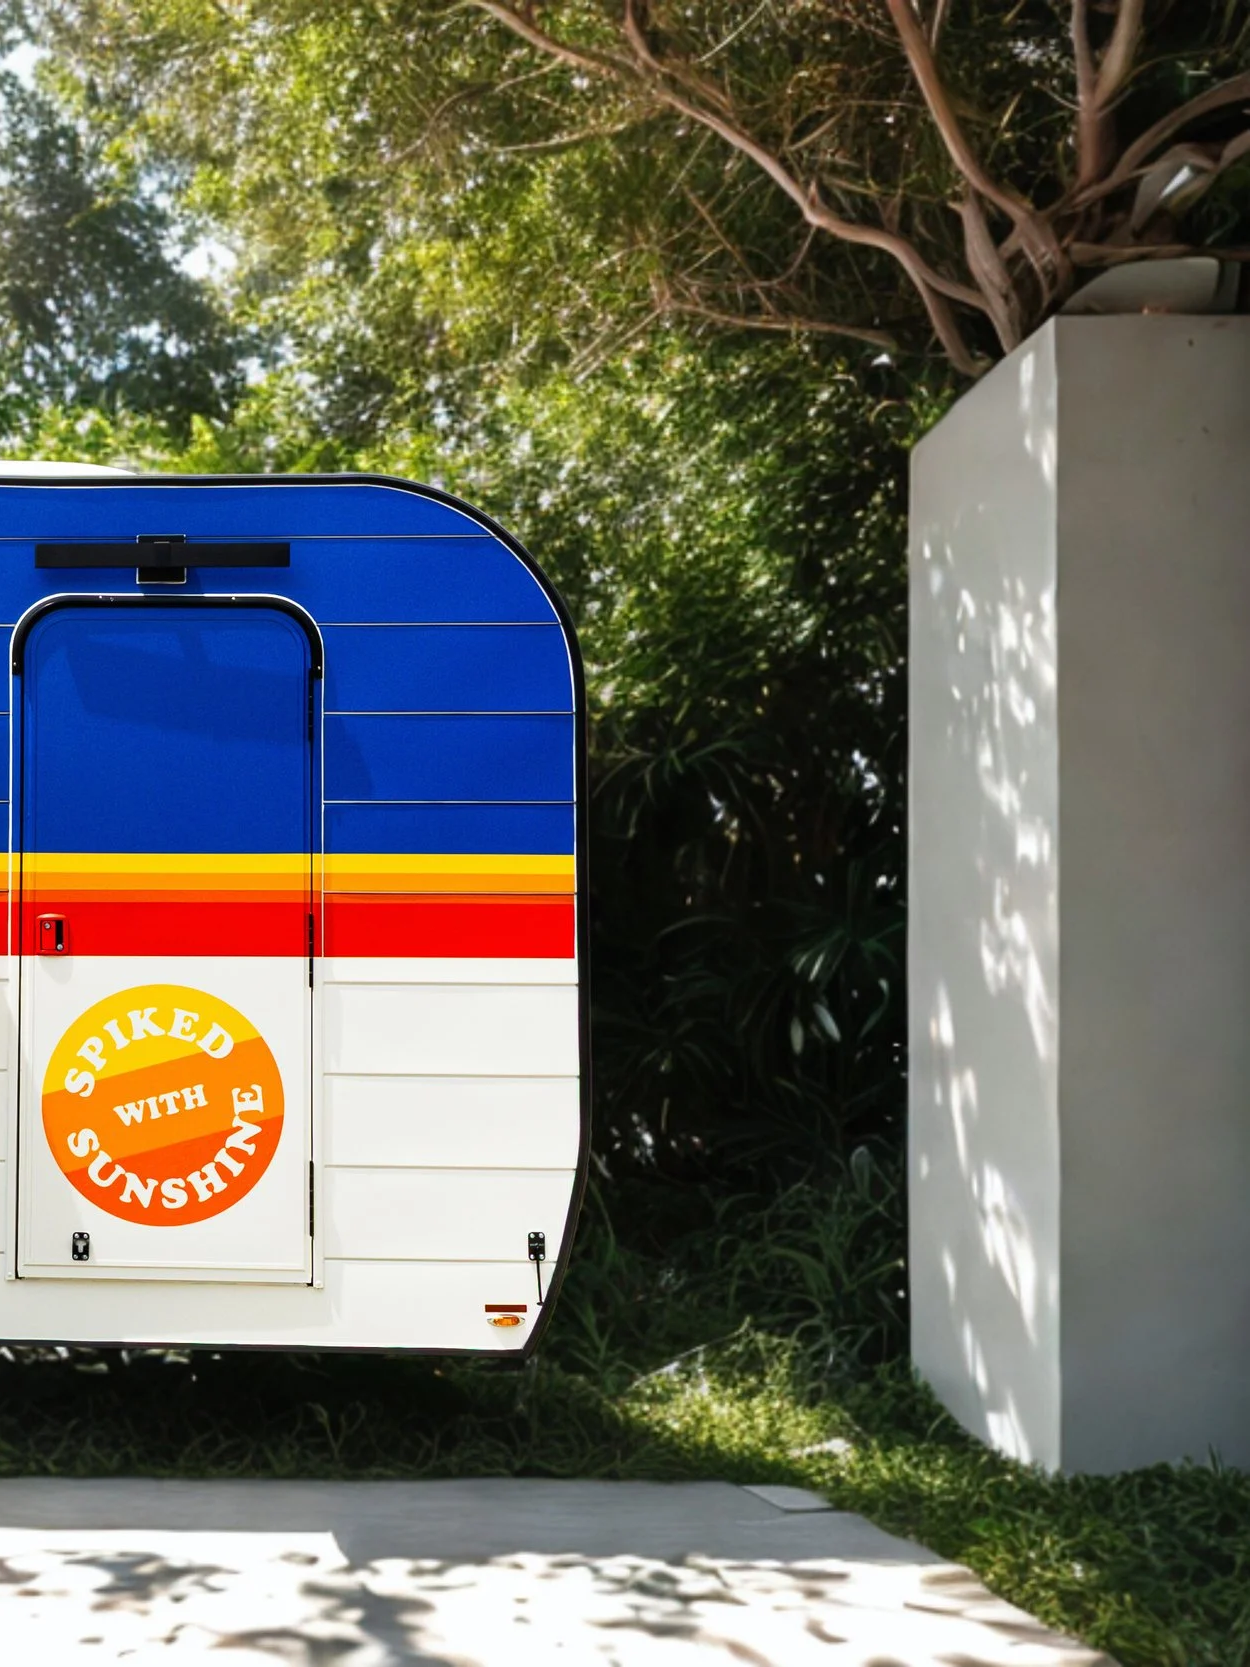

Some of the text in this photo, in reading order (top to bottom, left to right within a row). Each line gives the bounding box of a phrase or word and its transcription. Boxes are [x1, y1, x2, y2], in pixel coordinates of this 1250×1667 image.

[63, 1006, 235, 1098] SPIKED
[66, 1083, 265, 1210] SUNSHINE
[112, 1083, 209, 1127] WITH
